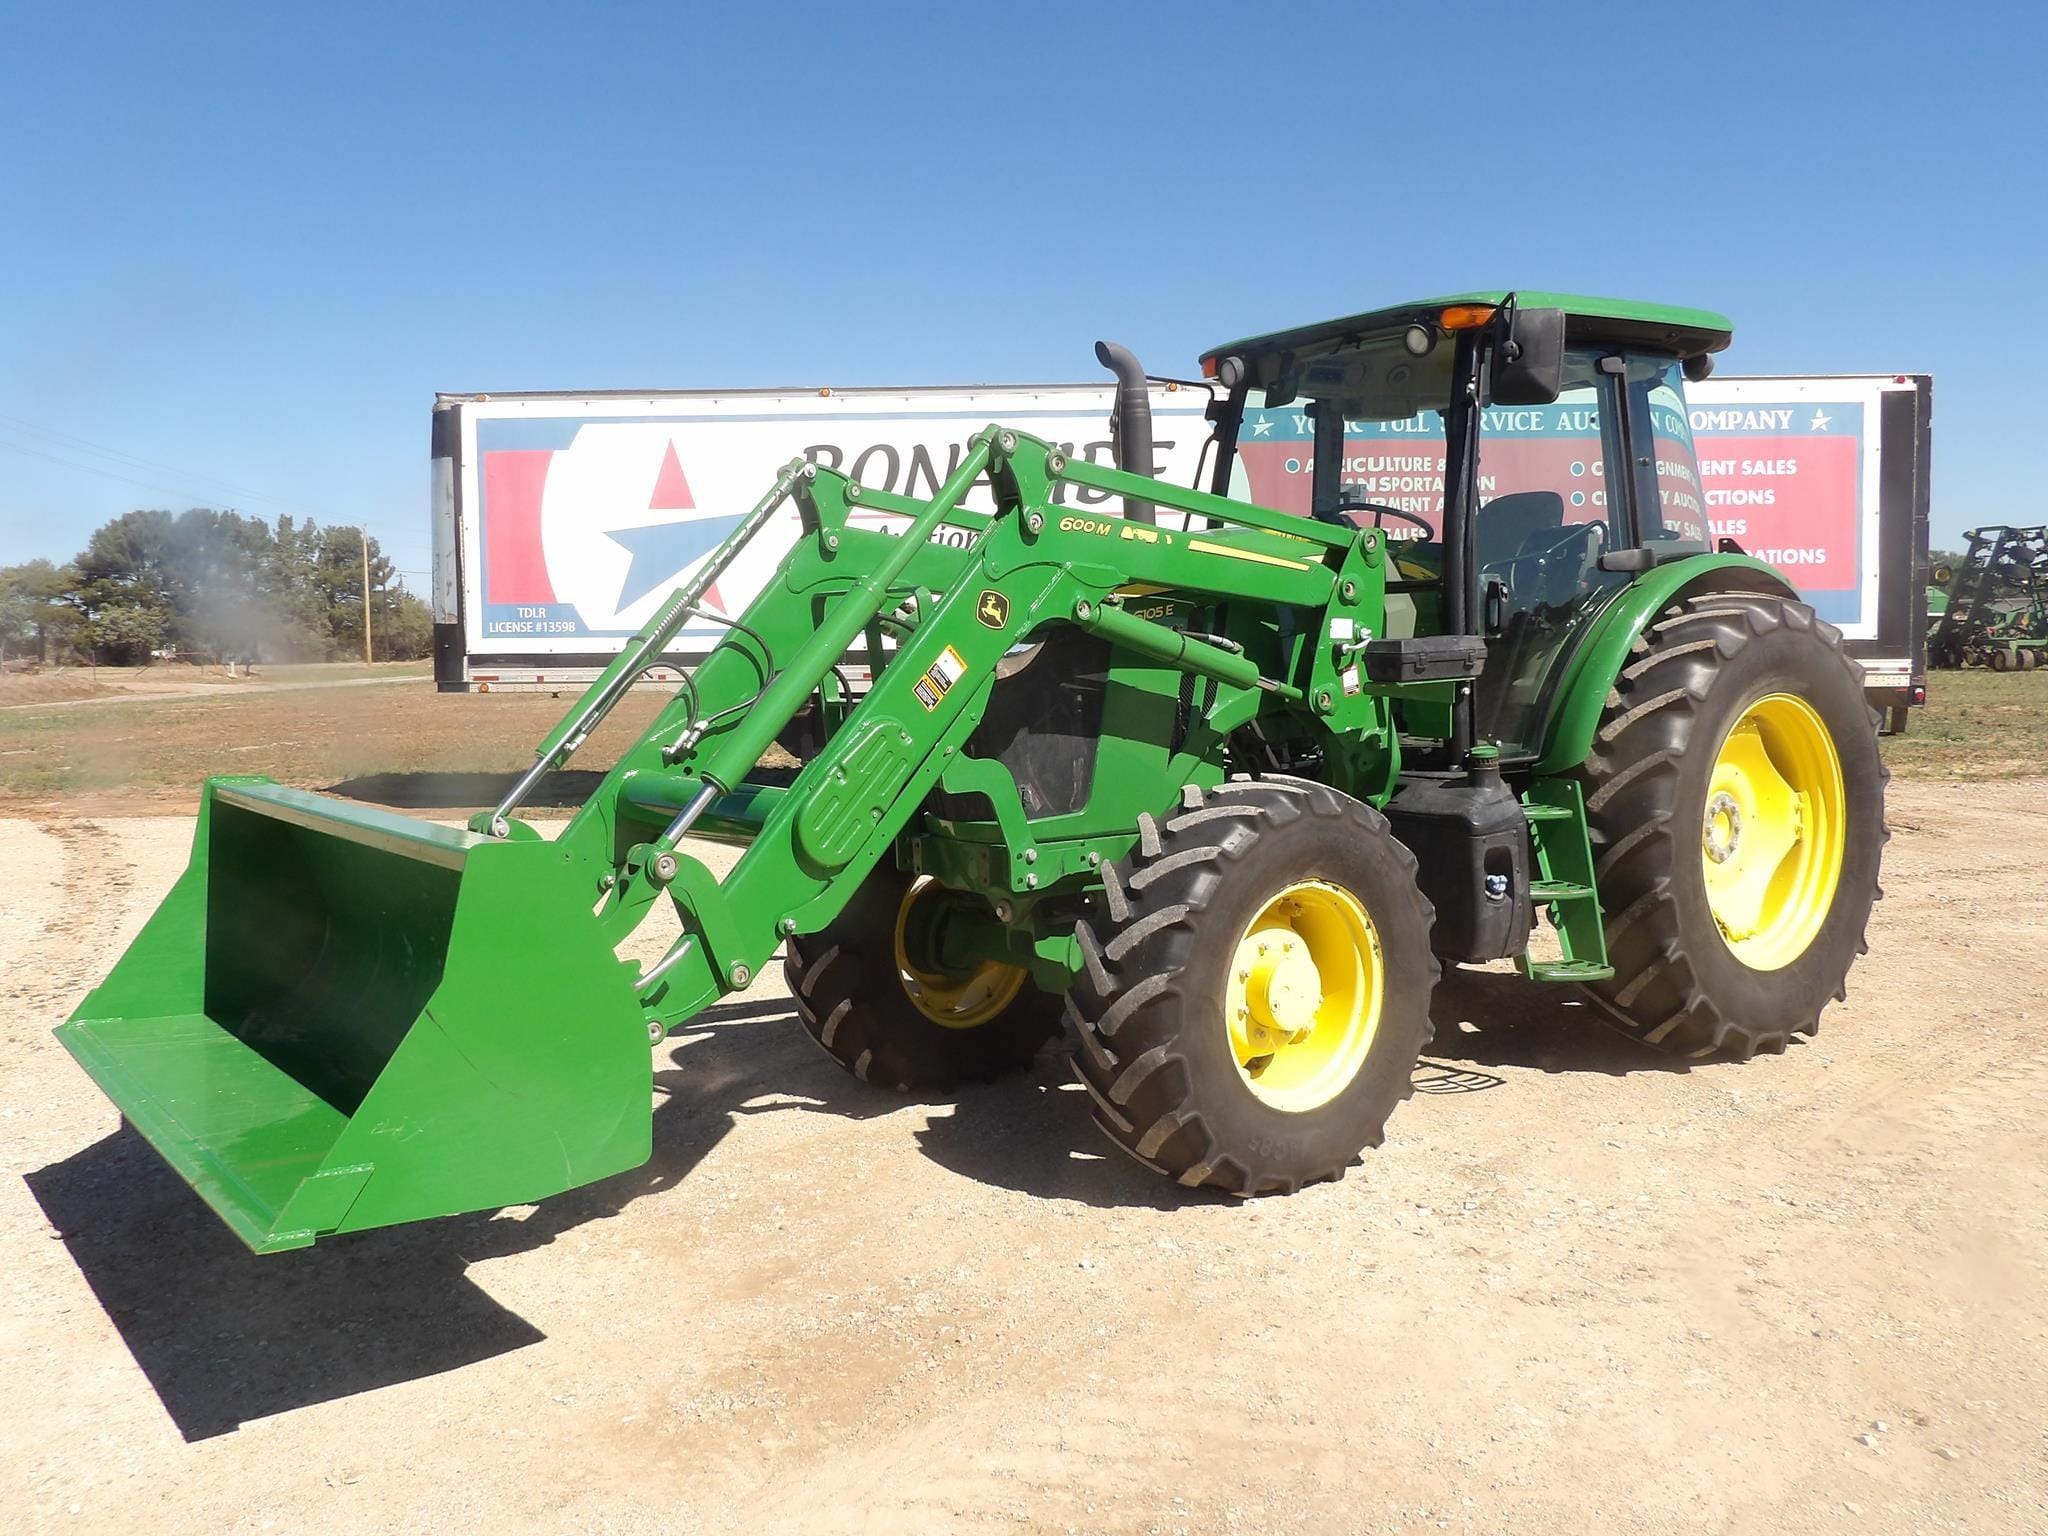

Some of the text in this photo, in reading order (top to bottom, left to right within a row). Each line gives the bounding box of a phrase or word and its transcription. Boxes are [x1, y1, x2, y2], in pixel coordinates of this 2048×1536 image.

[1292, 415, 1363, 434] YR
[1440, 411, 1544, 431] RVICE
[1556, 411, 1659, 431] AUCN
[1304, 457, 1432, 473] AICULTURE
[1742, 459, 1797, 475] SALES
[517, 607, 546, 618] TDLR
[489, 622, 576, 633] LICENSE #13598
